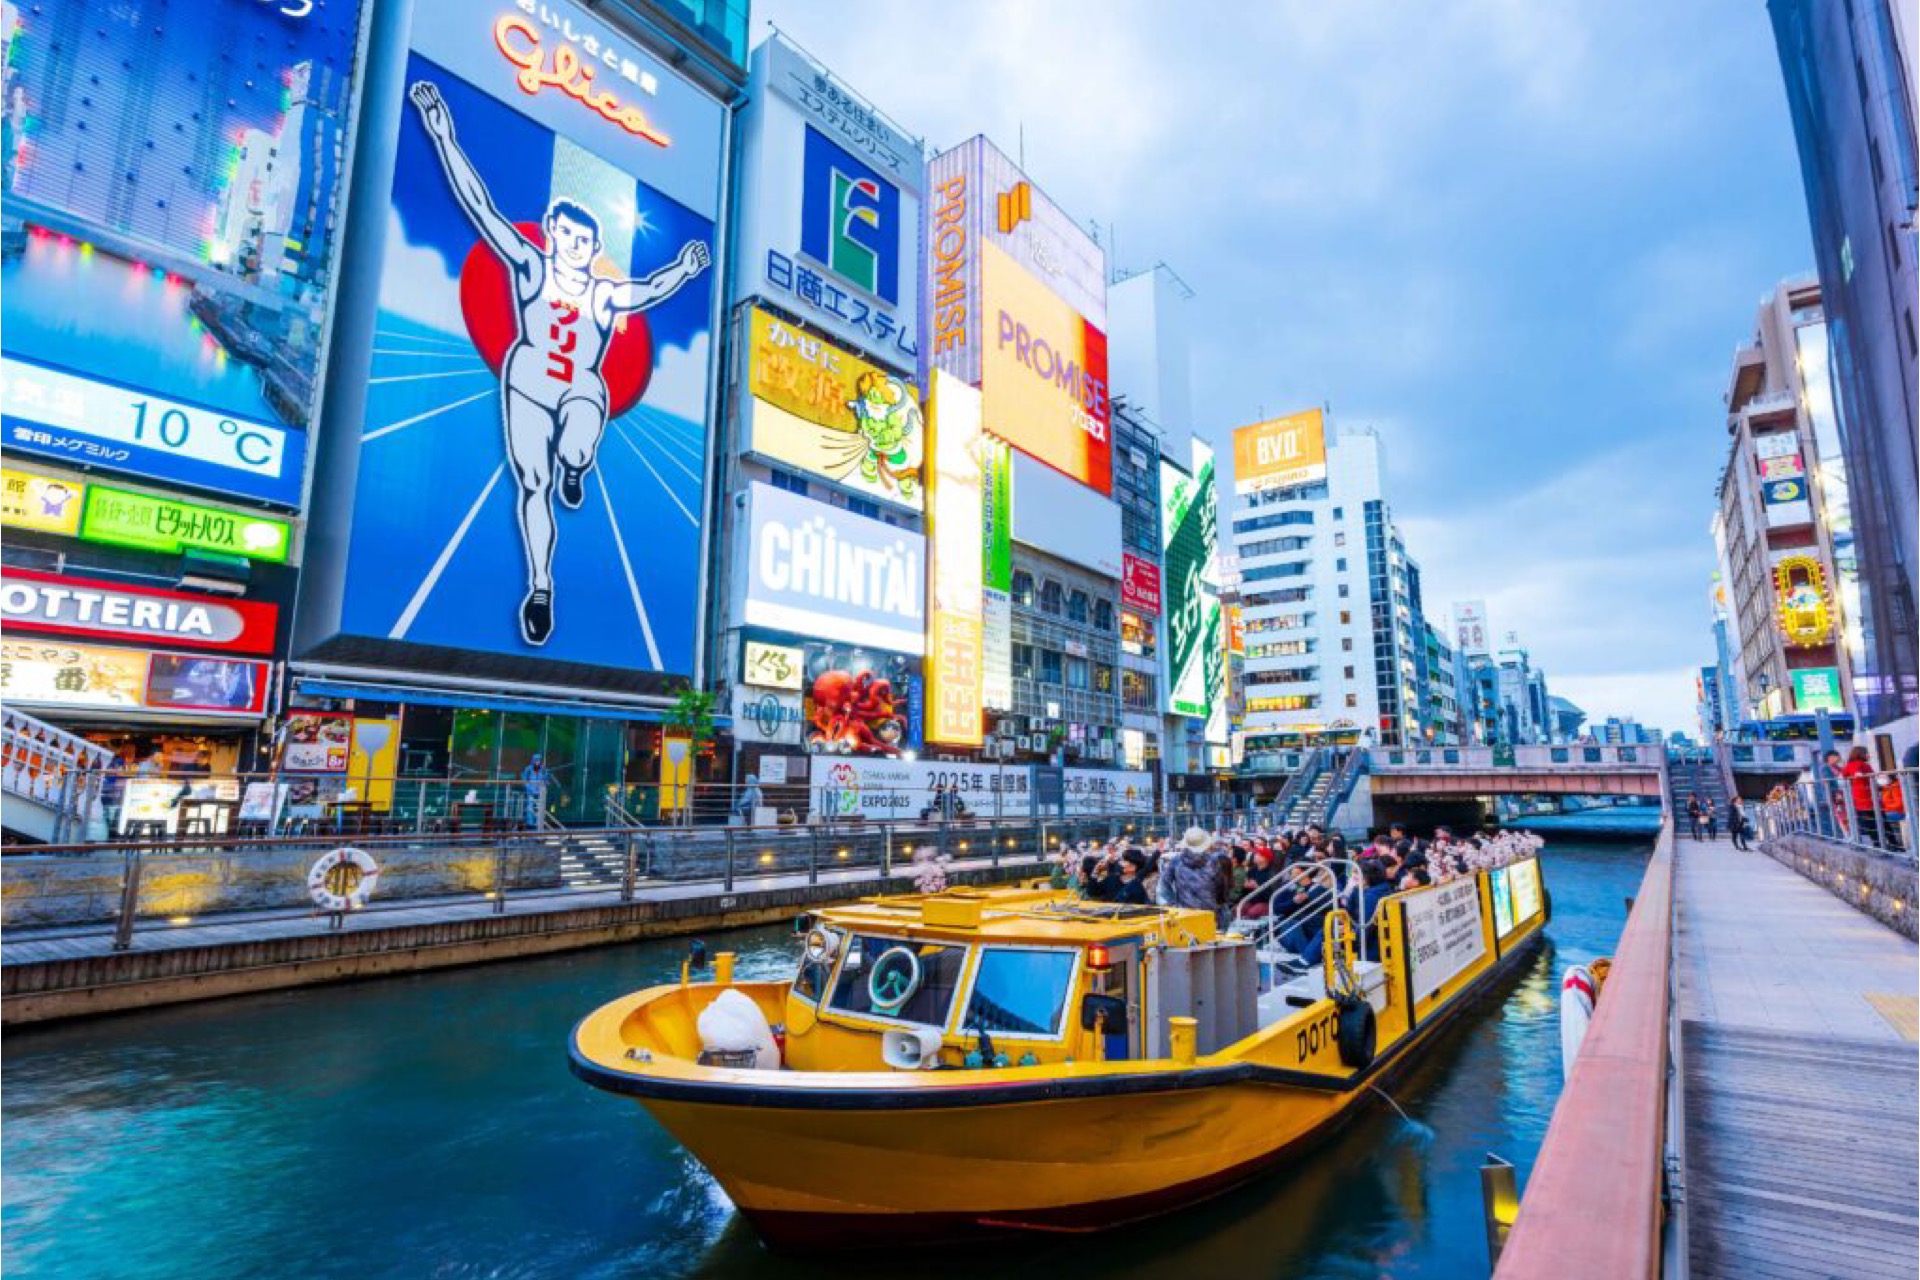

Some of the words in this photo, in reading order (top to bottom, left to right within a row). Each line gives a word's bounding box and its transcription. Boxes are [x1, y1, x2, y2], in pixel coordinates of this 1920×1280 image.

[494, 14, 671, 148] Glico
[767, 248, 918, 357] 日商エステム
[933, 176, 967, 356] PROMISE
[546, 299, 580, 384] グリコ
[767, 321, 841, 374] かぜに
[998, 309, 1106, 418] PROMISE
[131, 400, 190, 448] 10
[154, 504, 236, 547] ピタットハウス
[759, 515, 920, 619] CHINTAI
